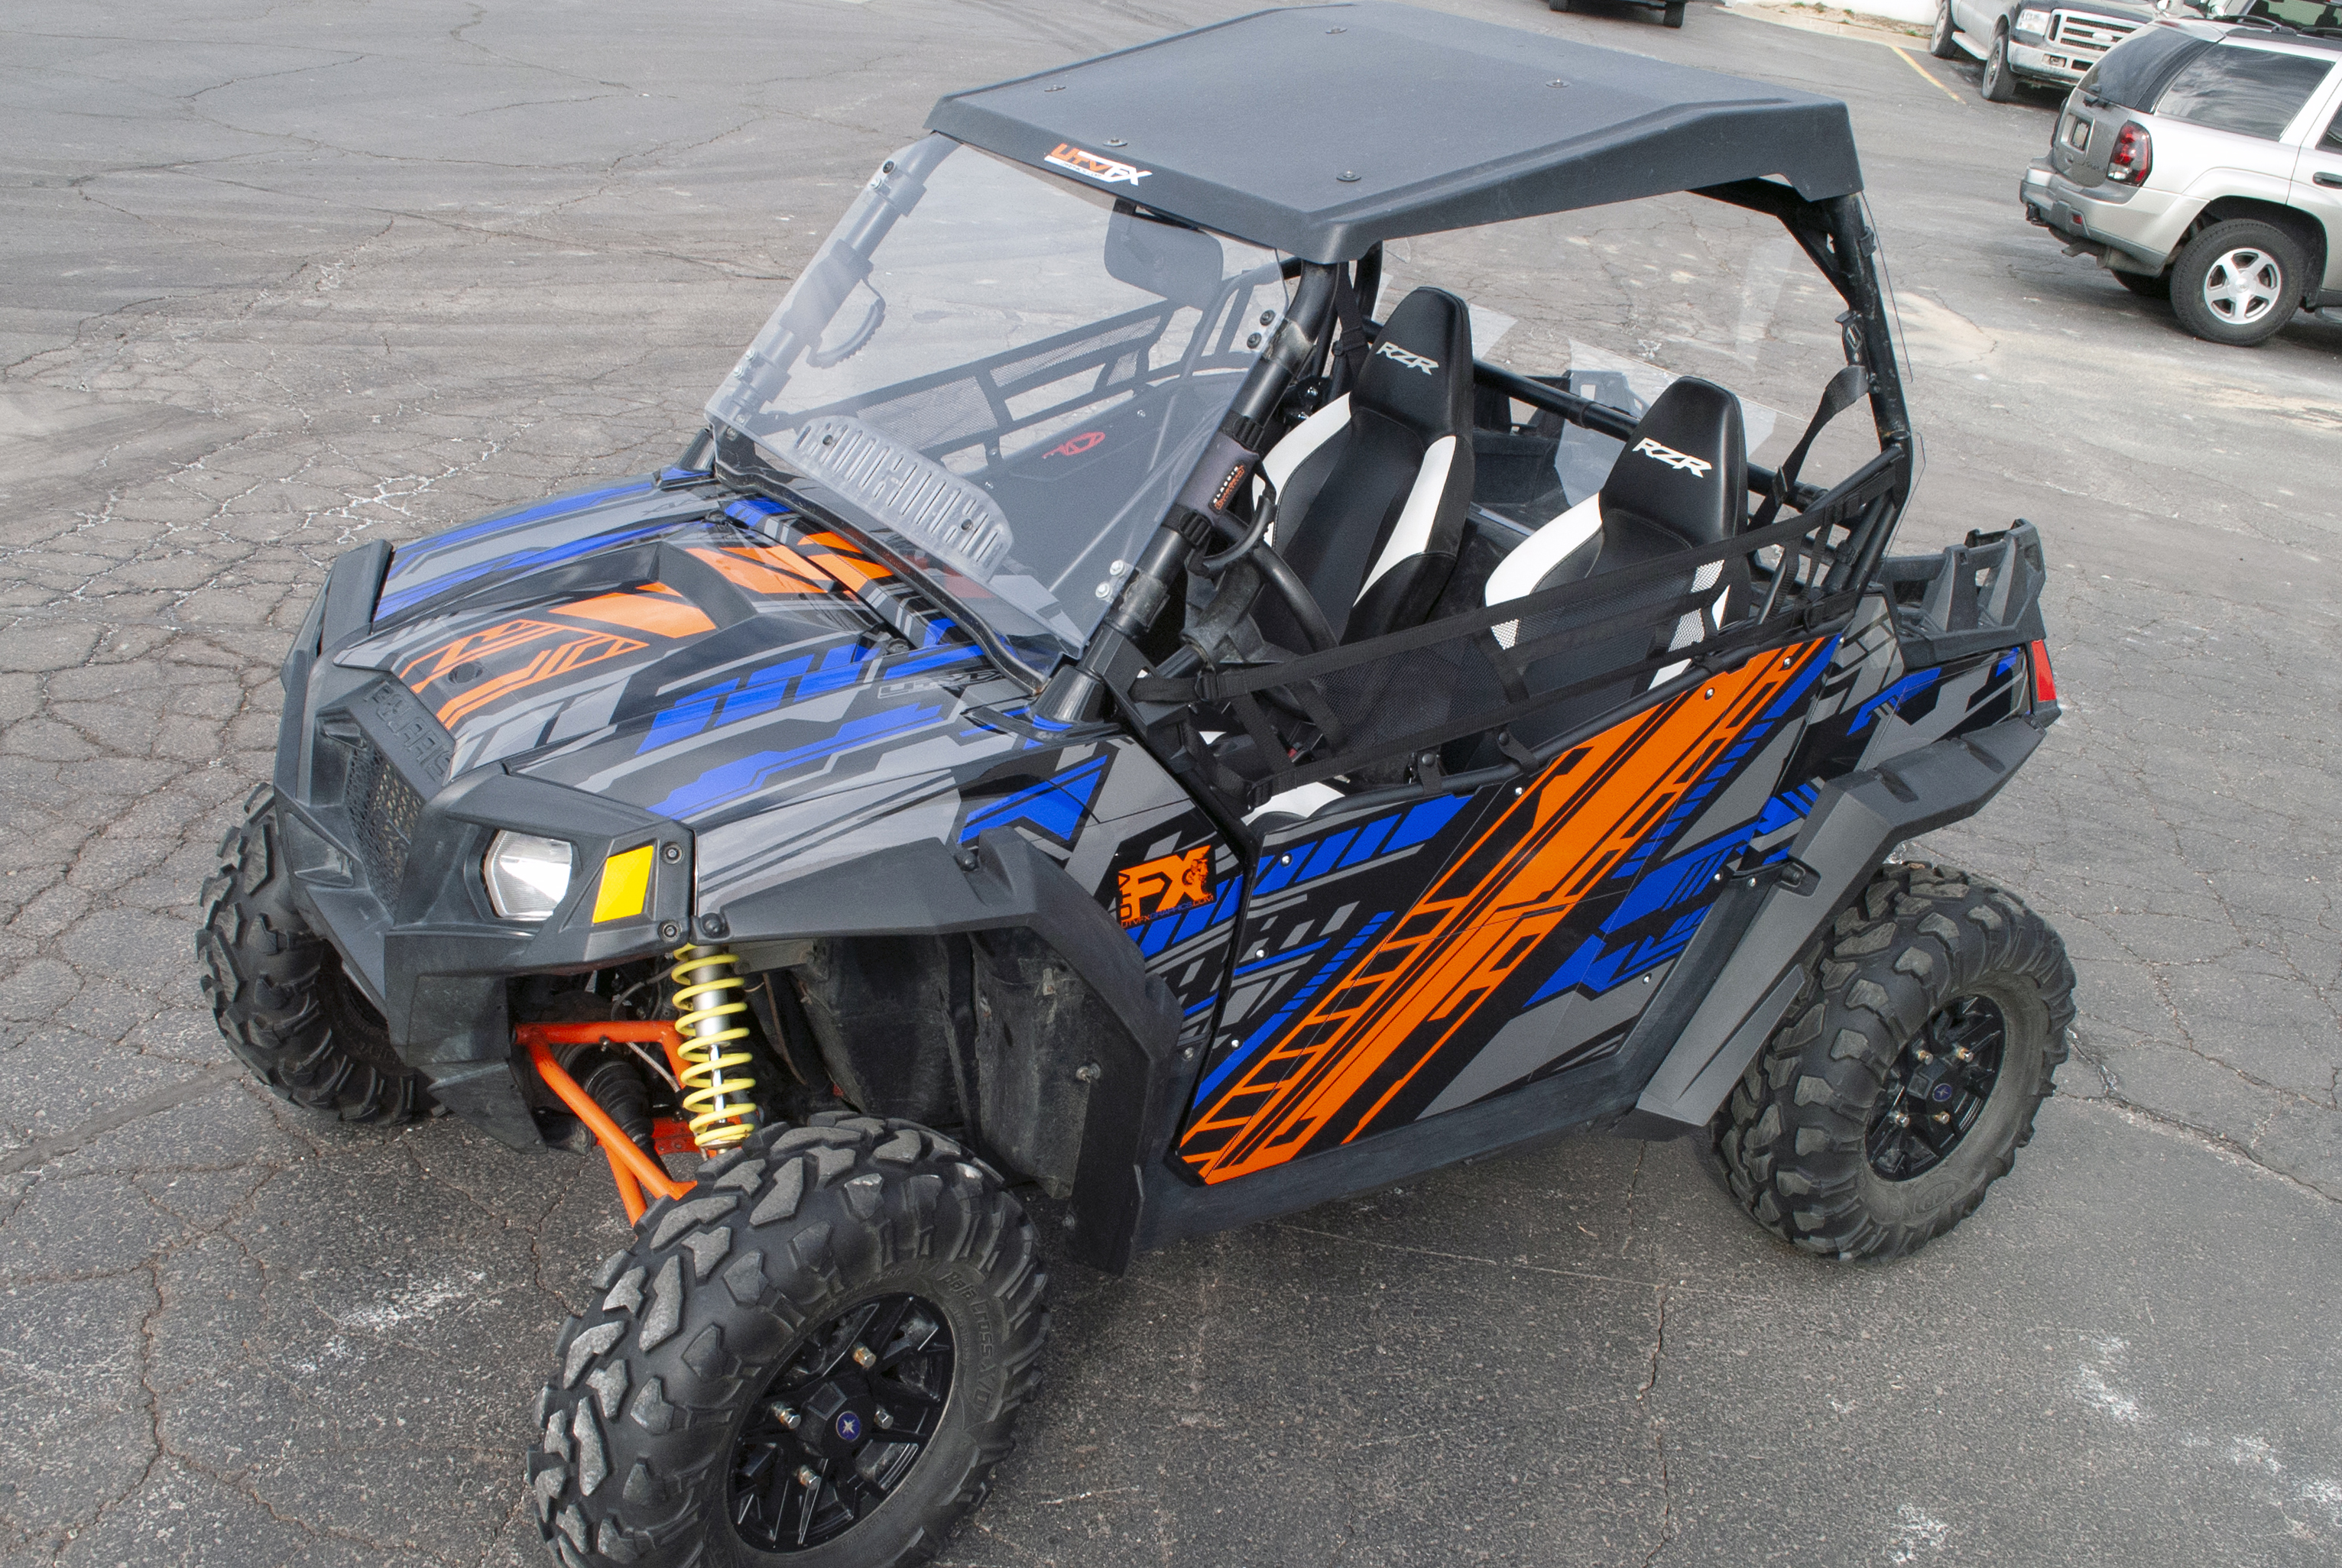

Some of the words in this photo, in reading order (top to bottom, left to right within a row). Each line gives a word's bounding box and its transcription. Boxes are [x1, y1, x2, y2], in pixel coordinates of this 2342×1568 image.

[1376, 342, 1439, 375] RZR
[1632, 437, 1712, 478] RZR
[364, 680, 451, 782] POLARIS
[970, 1301, 994, 1357] Cross
